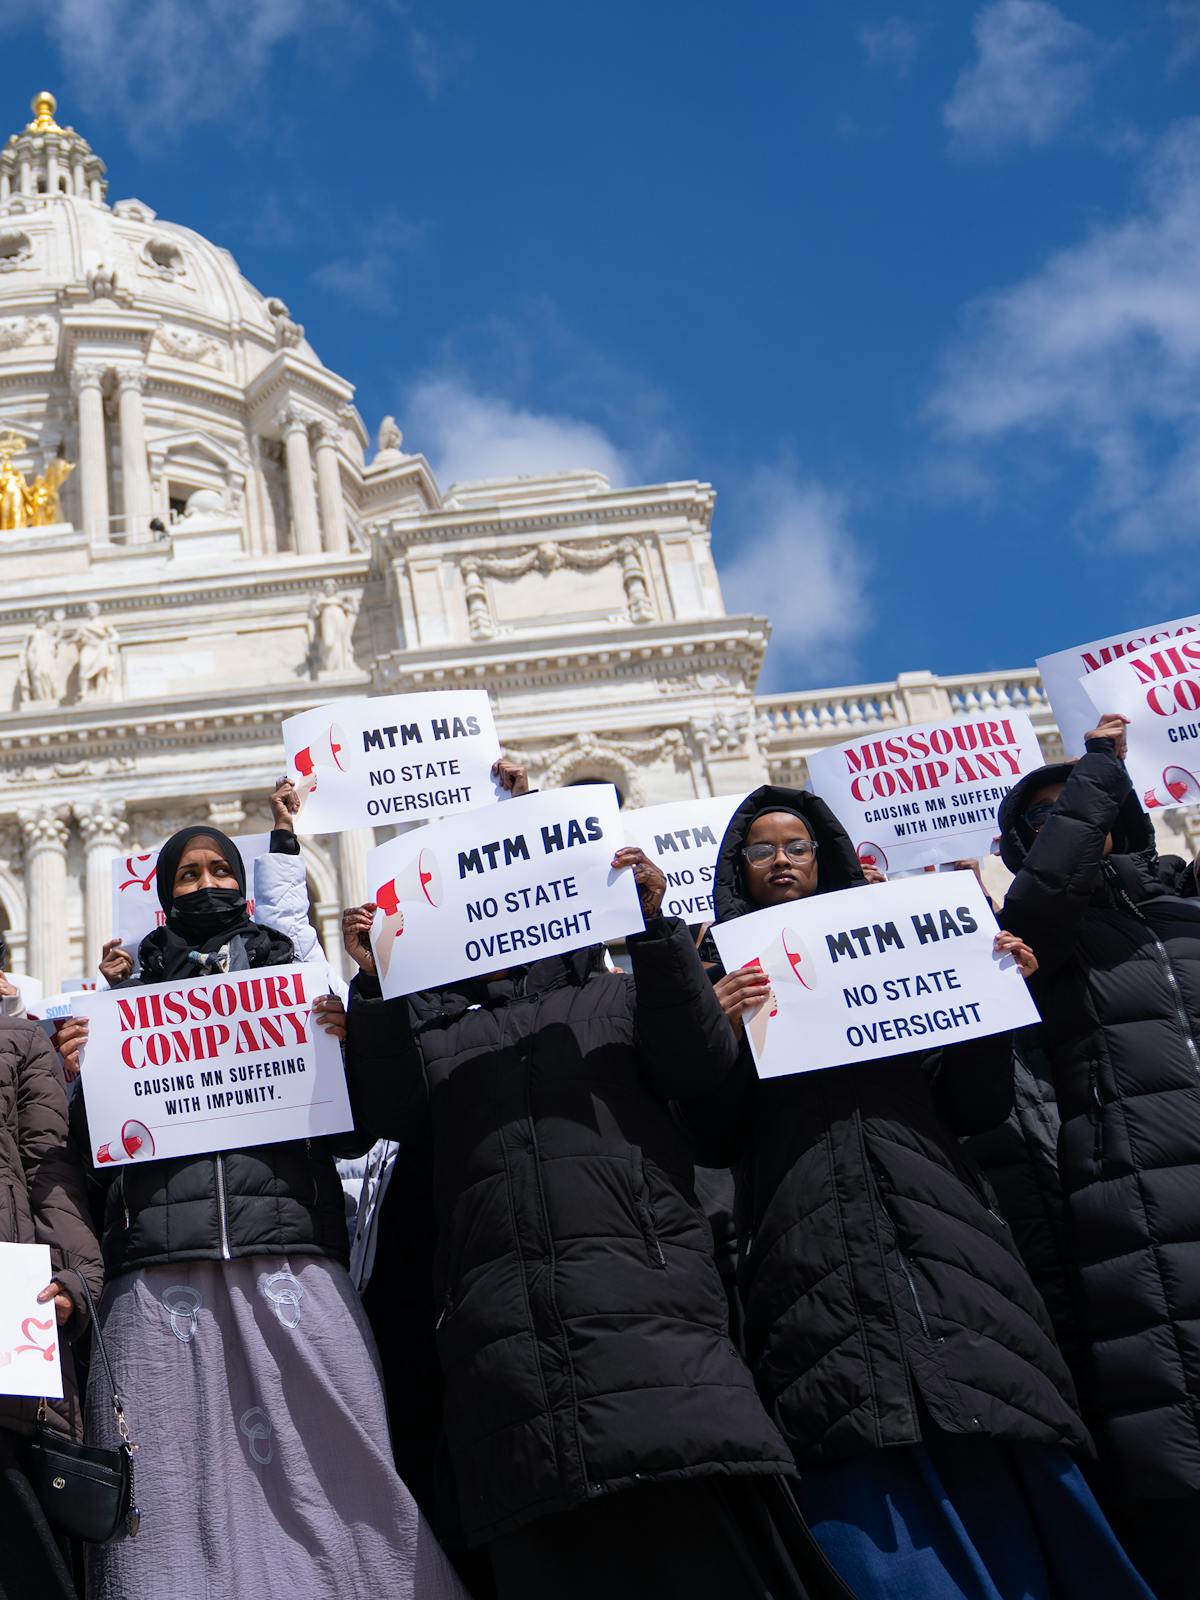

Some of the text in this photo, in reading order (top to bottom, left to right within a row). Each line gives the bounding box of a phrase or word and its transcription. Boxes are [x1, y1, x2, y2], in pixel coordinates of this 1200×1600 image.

[362, 715, 481, 752] MTM HAS
[843, 719, 1017, 775] MISSOURI
[369, 759, 461, 786] NO STATE
[850, 748, 1022, 802] COMPANY
[367, 786, 472, 816] OVERSIGHT
[864, 802, 920, 824] CAUSING
[925, 797, 947, 813] MN
[654, 825, 717, 855] MTM
[894, 817, 928, 837] WITH
[457, 816, 603, 879] MTM HAS
[666, 869, 694, 888] NO
[466, 876, 578, 923] NO STATE
[465, 910, 593, 962] OVERSIGHT
[825, 906, 978, 963] MTM HAS
[116, 973, 308, 1032] MISSOURI
[842, 968, 961, 1008] NO STATE
[121, 1009, 312, 1070] COMPANY
[846, 1002, 981, 1047] OVERSIGHT
[134, 1057, 306, 1097] CAUSING MN SUFFERING
[165, 1085, 282, 1116] WITH IMPUNITY.
